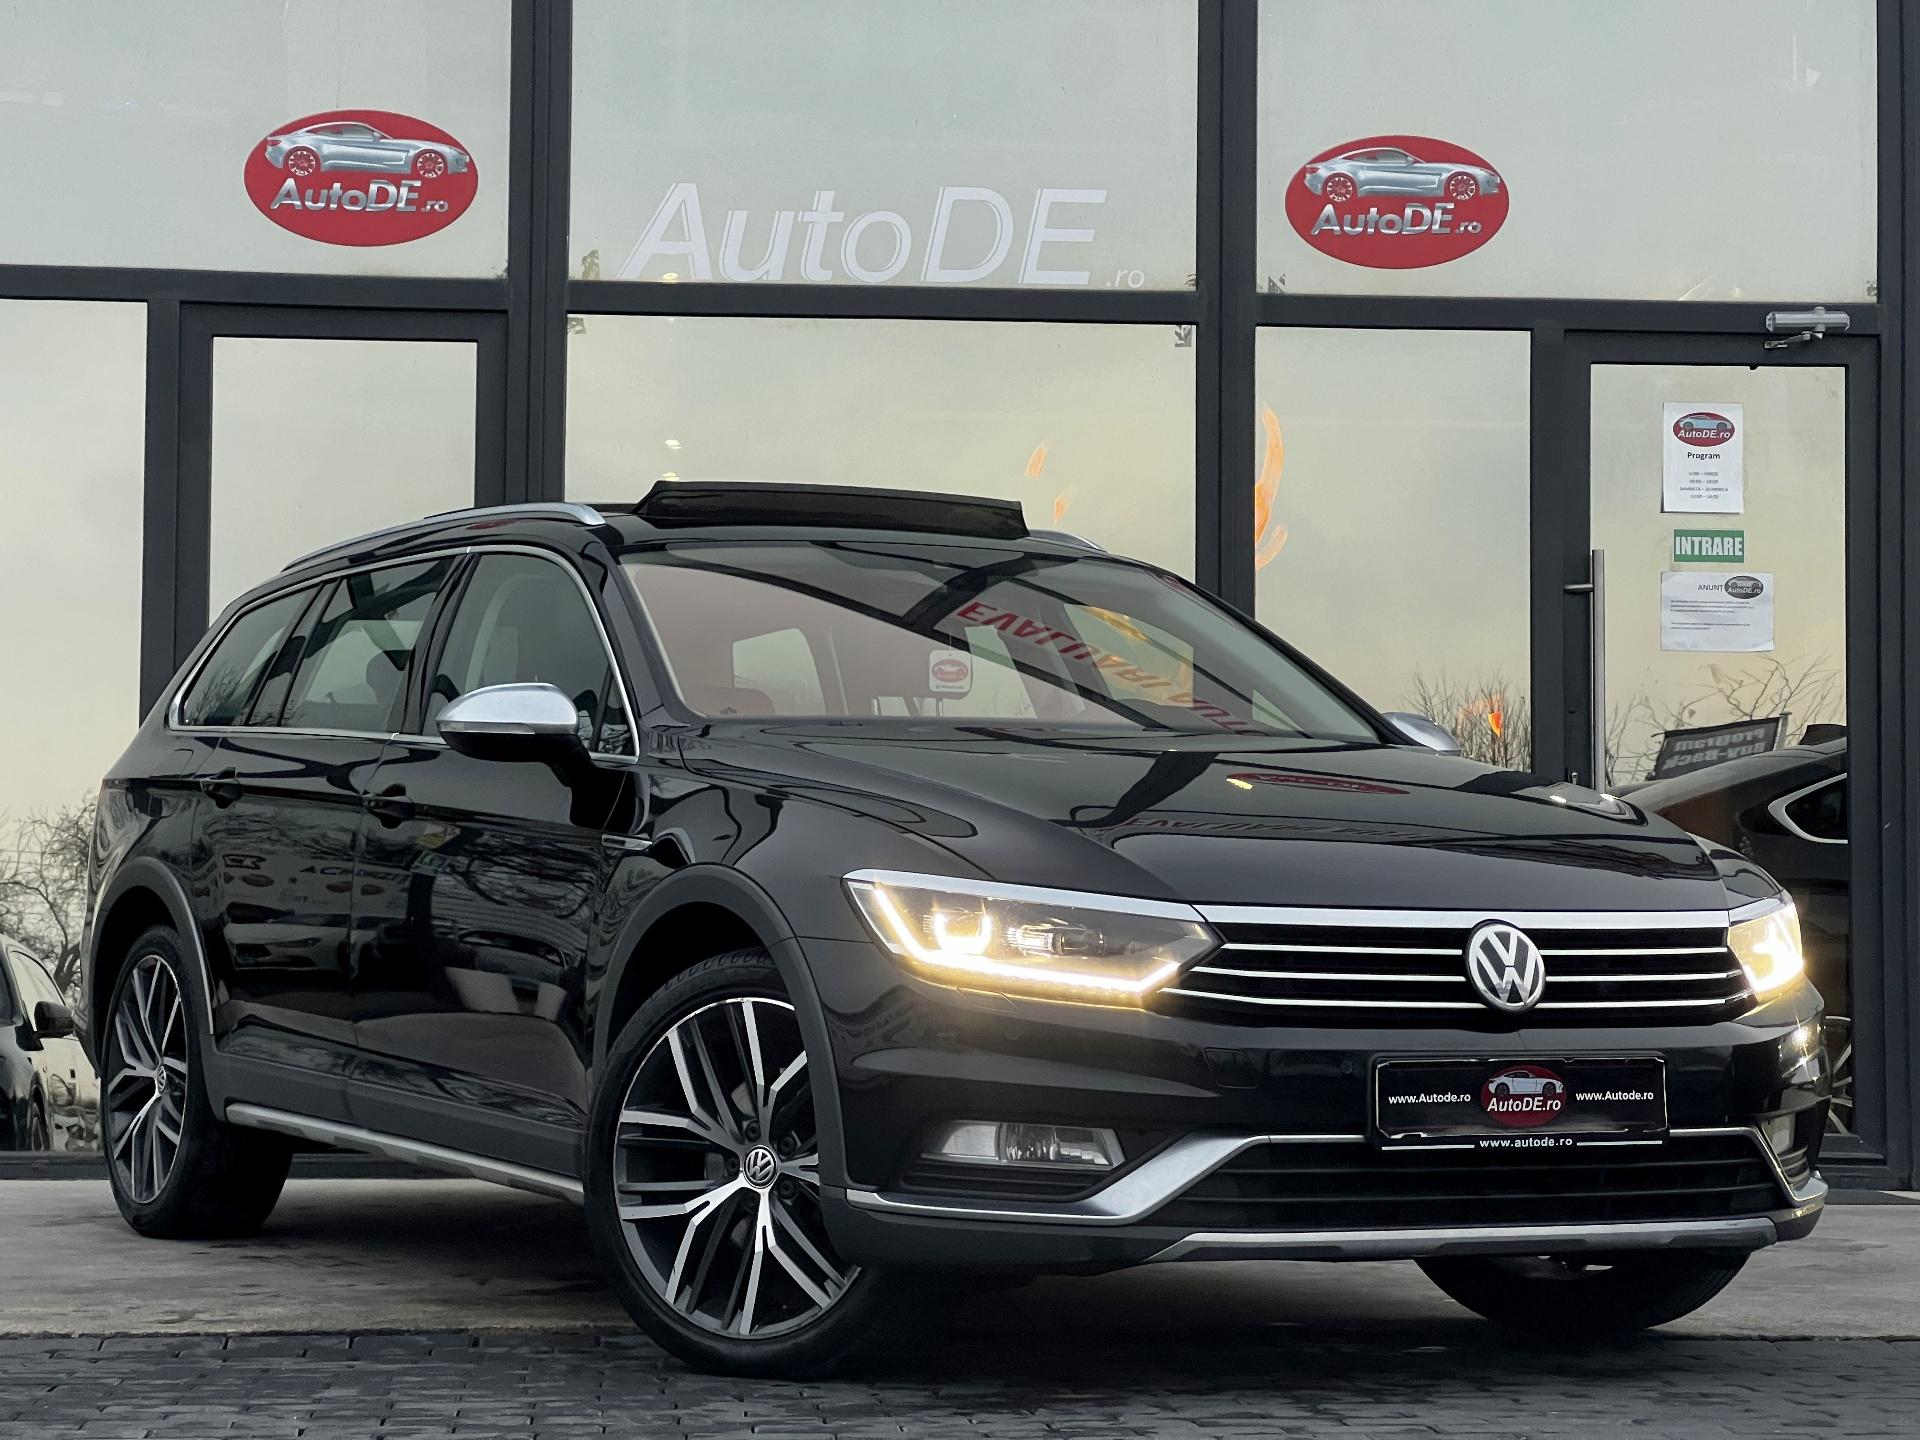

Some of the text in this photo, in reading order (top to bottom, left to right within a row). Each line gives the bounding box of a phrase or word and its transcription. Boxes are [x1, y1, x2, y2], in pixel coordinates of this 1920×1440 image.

[1687, 451, 1721, 460] Program
[1675, 536, 1743, 556] INTRARE
[1388, 1091, 1471, 1105] www.Autode.ro
[1575, 1089, 1654, 1101] www.Autode.ro
[1487, 1096, 1562, 1113] AutoDE.ro
[1479, 1136, 1573, 1149] www.autode.ro
